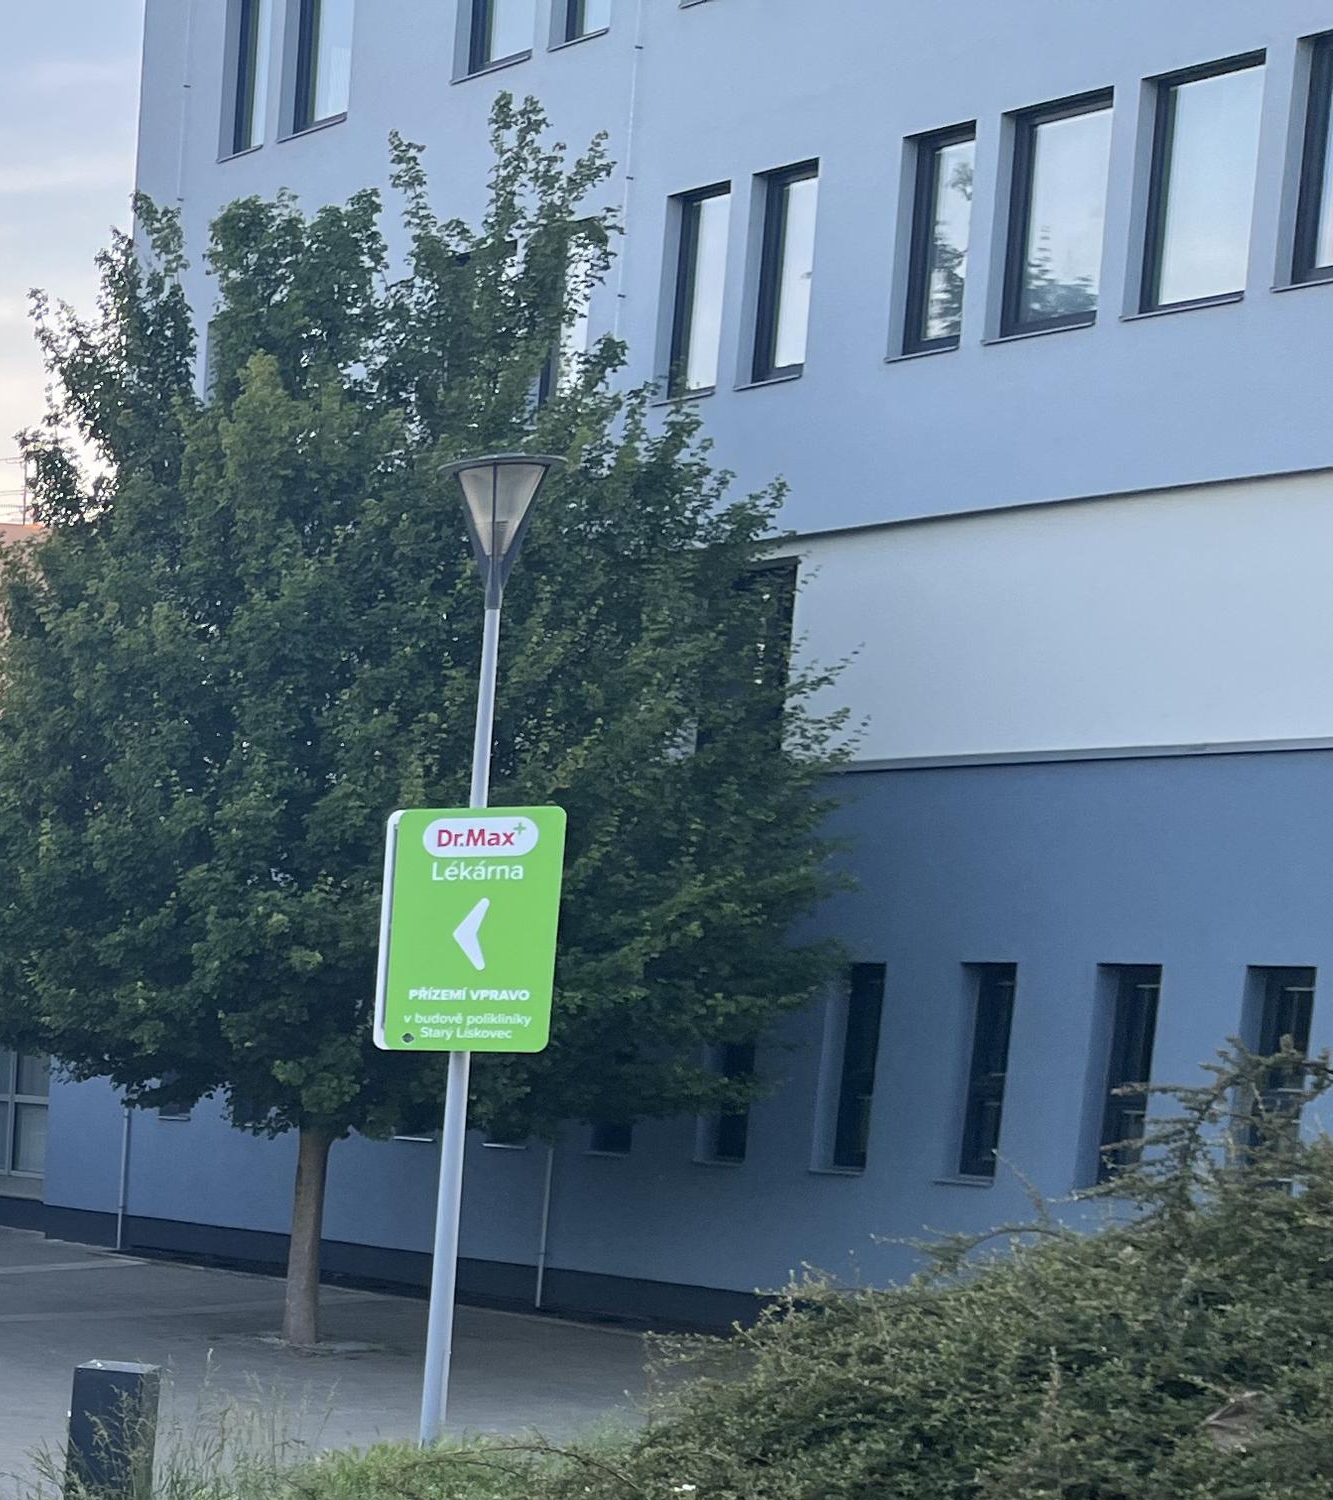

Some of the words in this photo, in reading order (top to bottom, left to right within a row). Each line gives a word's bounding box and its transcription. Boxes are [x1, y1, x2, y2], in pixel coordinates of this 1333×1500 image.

[432, 860, 524, 882] Lékárna
[408, 987, 466, 1001] PŘÍZEMÍ
[469, 989, 530, 1001] VPRAVO
[404, 1015, 412, 1024] v
[414, 1013, 463, 1025] budově
[466, 1013, 532, 1028] polikliniky
[420, 1026, 454, 1041] Starý
